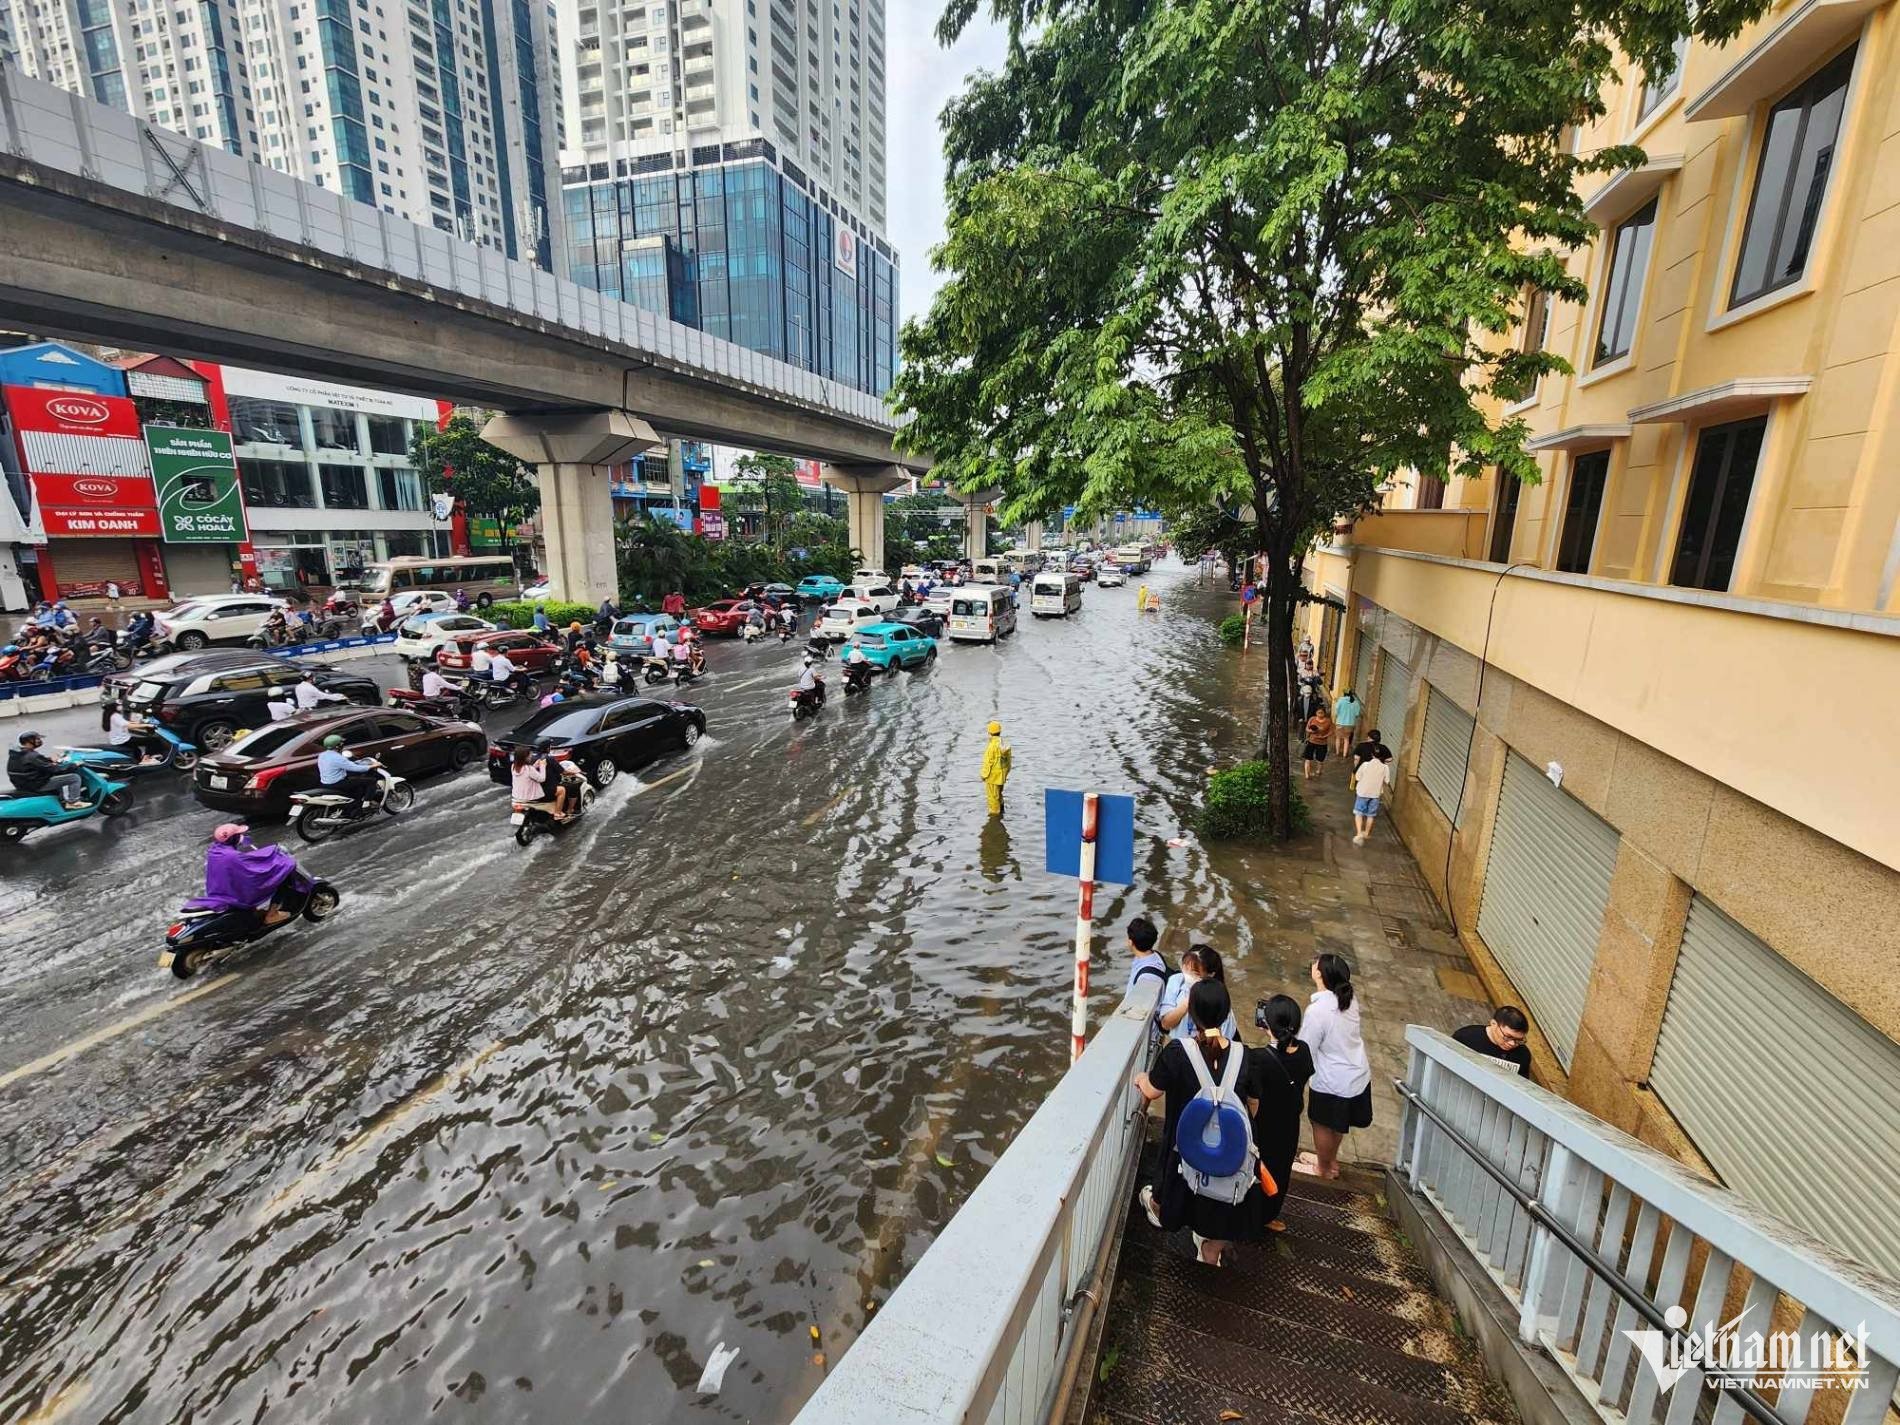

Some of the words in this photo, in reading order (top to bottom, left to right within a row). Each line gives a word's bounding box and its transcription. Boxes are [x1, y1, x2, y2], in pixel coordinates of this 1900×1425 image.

[54, 404, 102, 417] KOVA
[80, 483, 112, 492] KOVA
[67, 520, 96, 530] KIM
[98, 520, 138, 530] OANH
